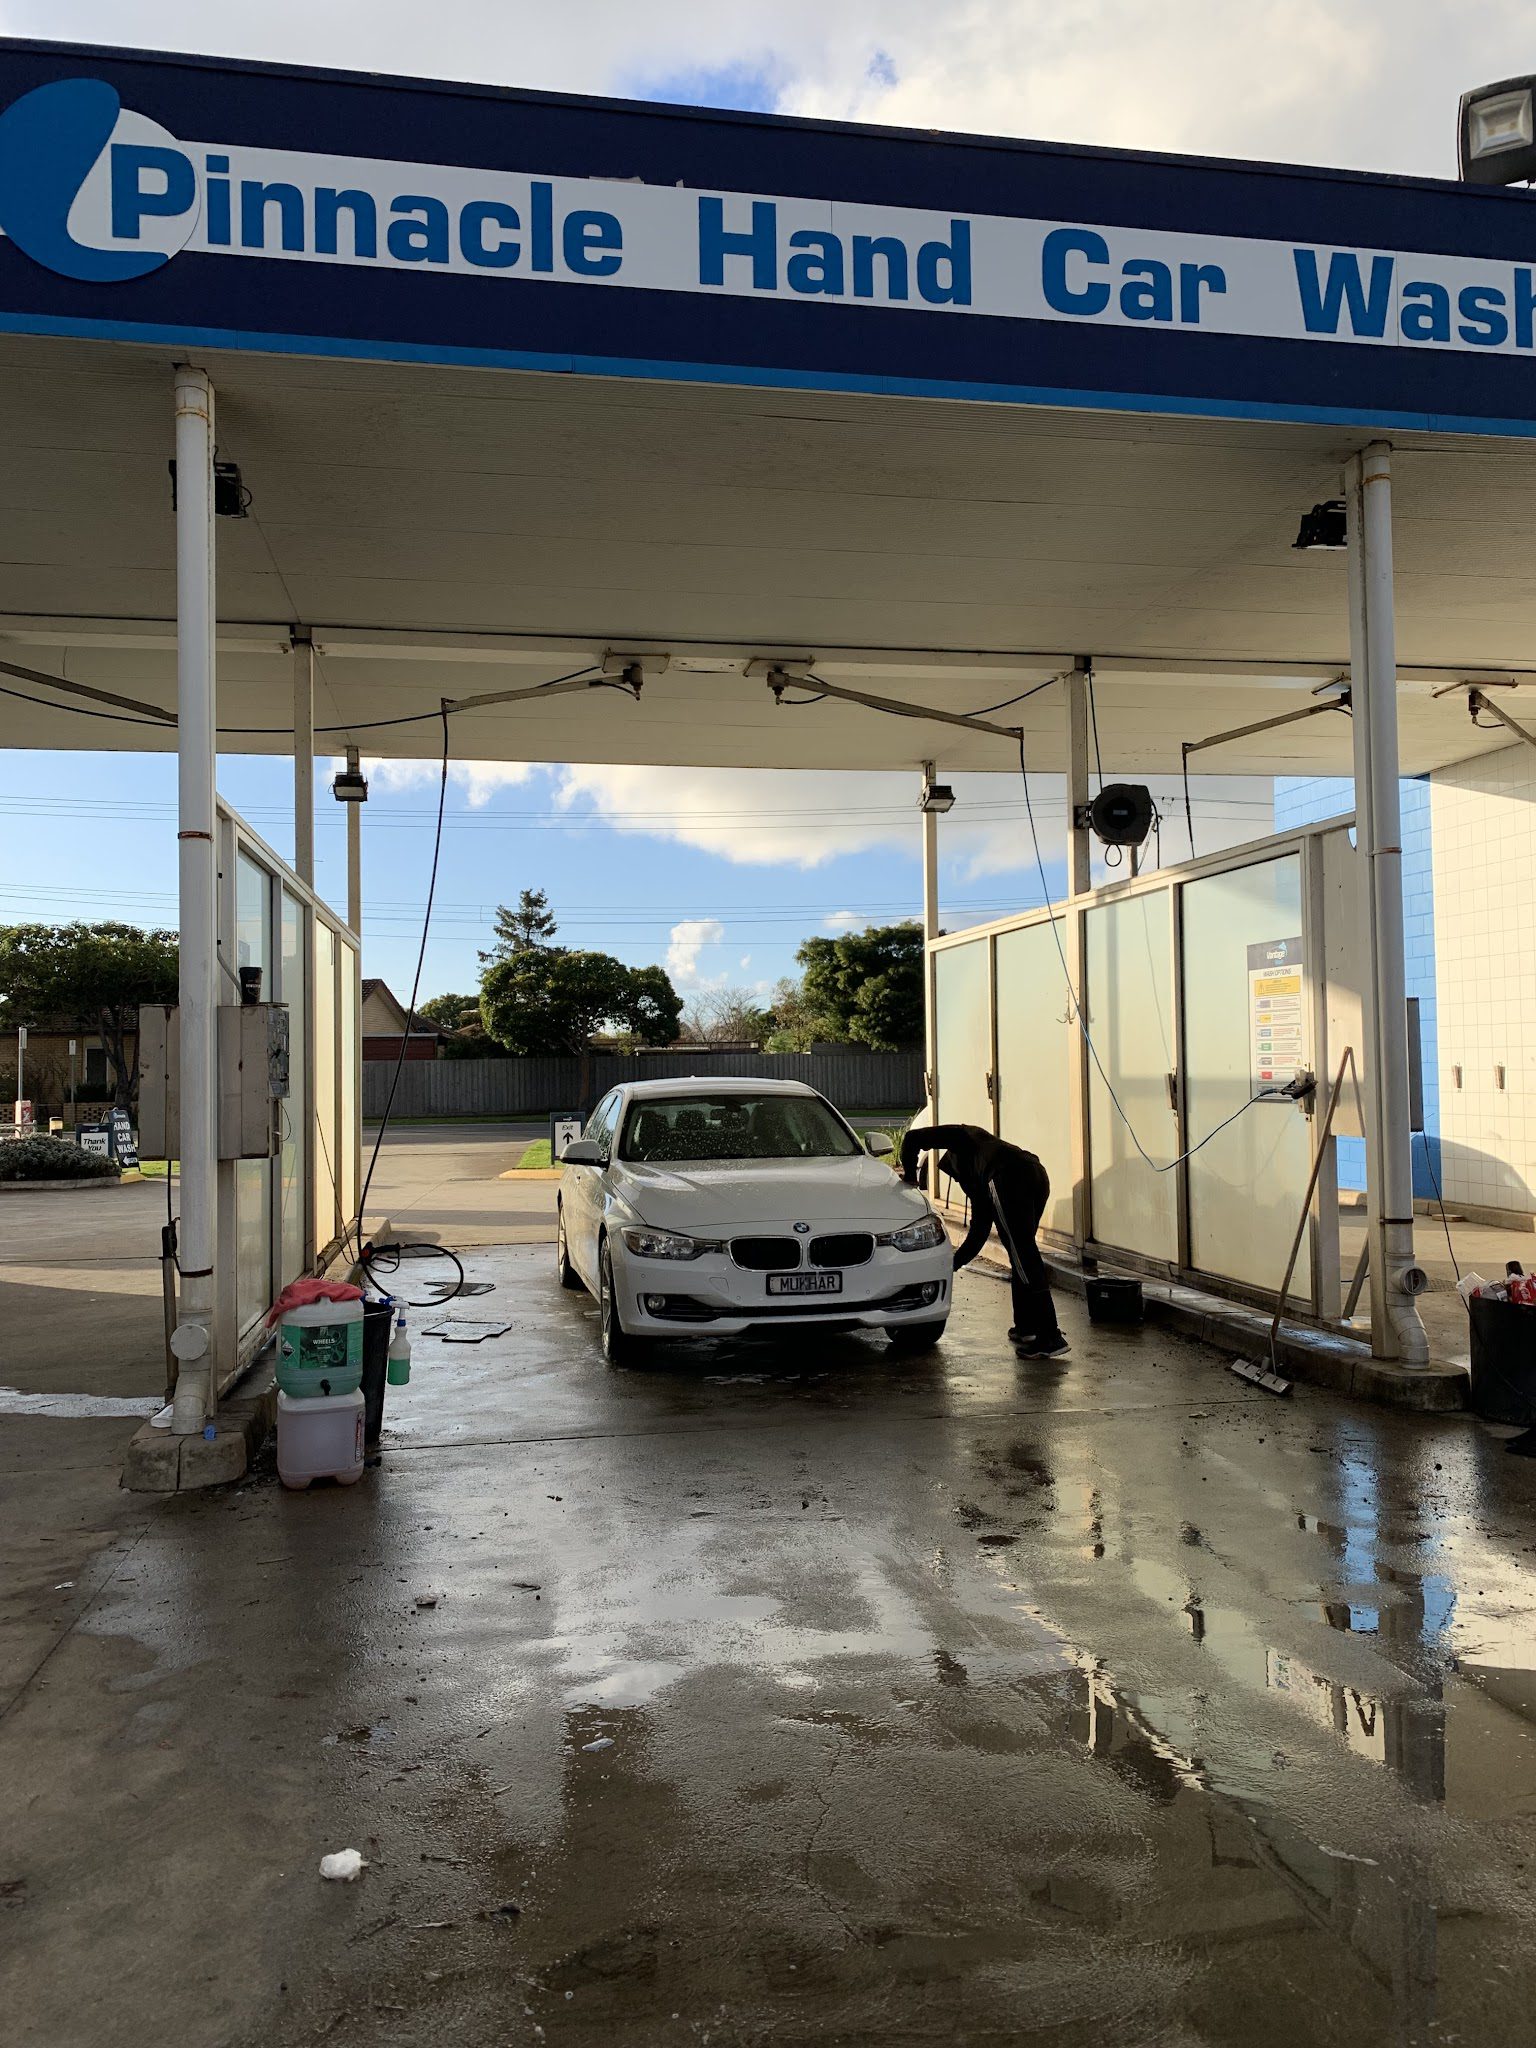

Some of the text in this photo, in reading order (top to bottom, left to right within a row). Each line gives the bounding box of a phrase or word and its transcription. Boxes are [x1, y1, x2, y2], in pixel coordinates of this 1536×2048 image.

[110, 144, 624, 277] Pinnacle
[699, 197, 972, 306] Hand
[1042, 228, 1228, 324] Car
[114, 1122, 130, 1131] HAND
[117, 1133, 131, 1142] CAR
[117, 1144, 136, 1153] WASH
[780, 1276, 835, 1291] MUKHAR
